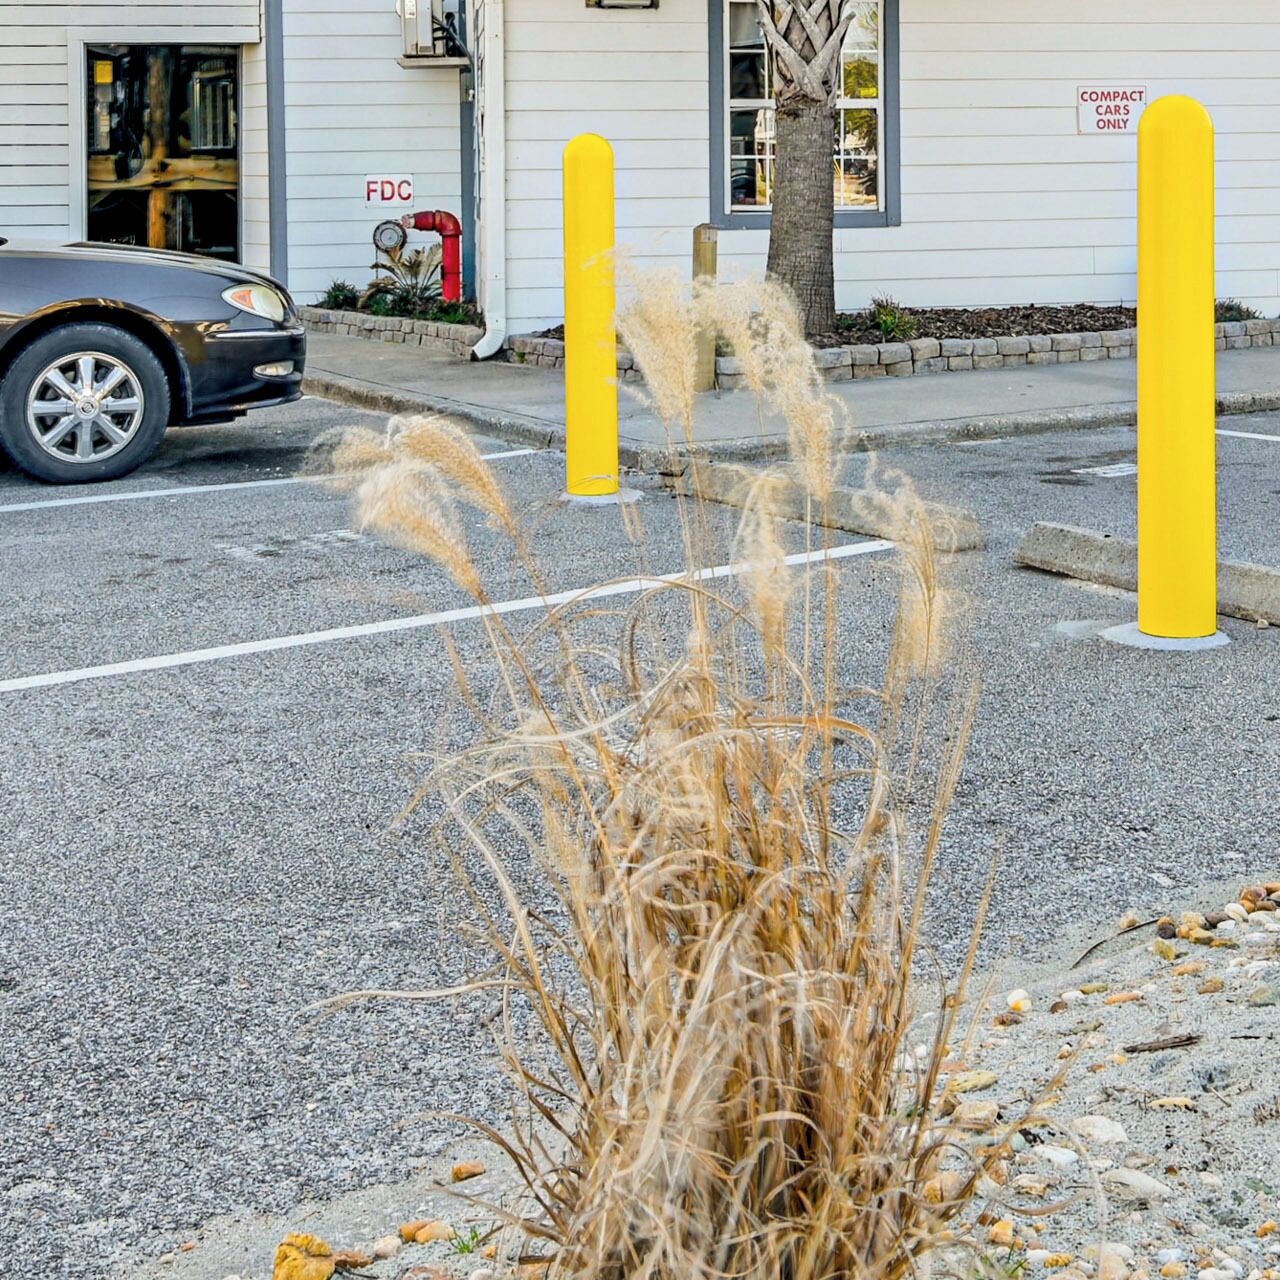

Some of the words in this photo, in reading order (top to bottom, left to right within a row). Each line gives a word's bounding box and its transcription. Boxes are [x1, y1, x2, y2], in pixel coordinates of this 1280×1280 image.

[1080, 90, 1144, 102] COMPACT
[1095, 104, 1130, 116] CARS
[1096, 118, 1129, 130] ONLY
[366, 180, 412, 201] FDC
